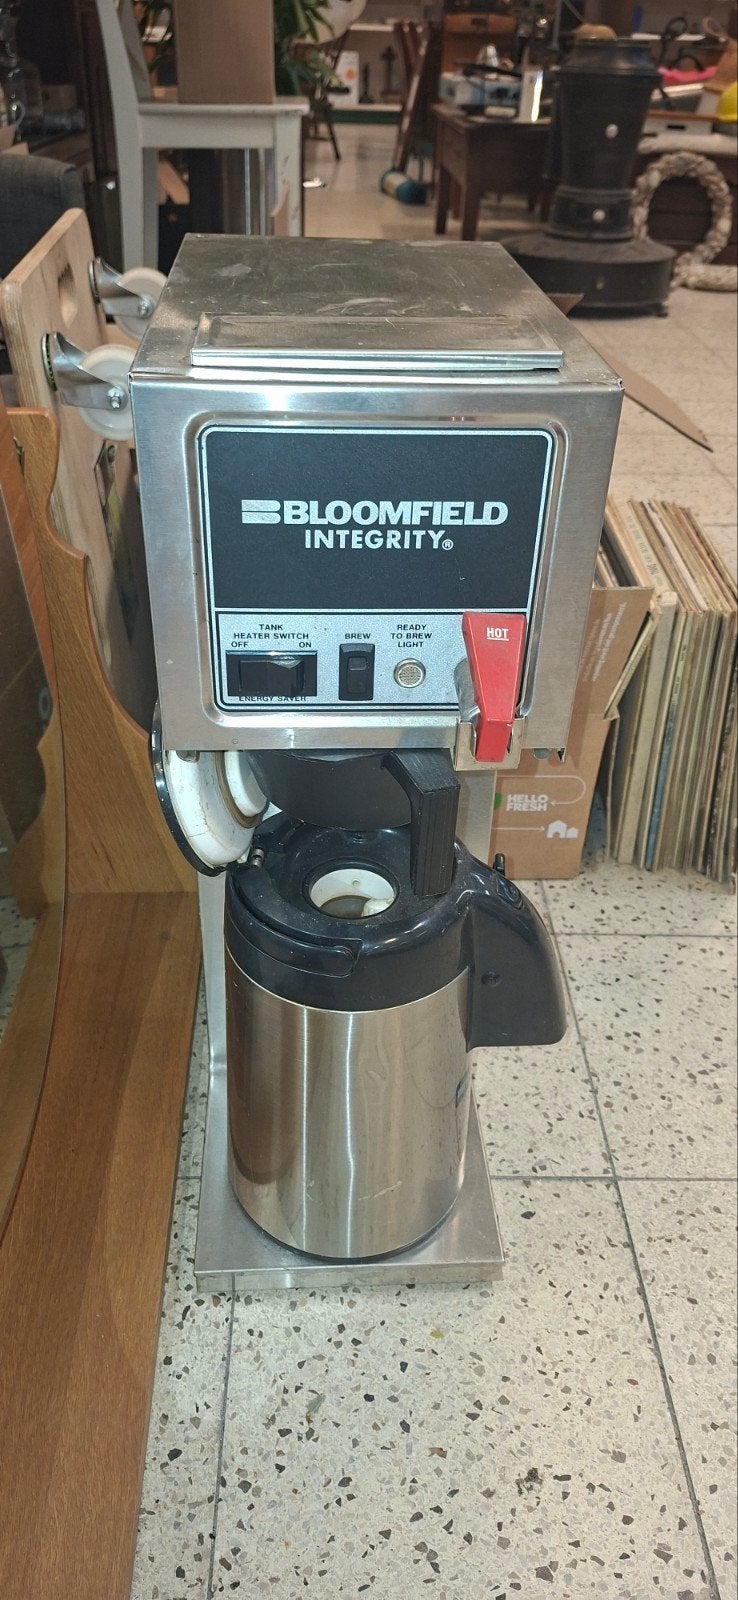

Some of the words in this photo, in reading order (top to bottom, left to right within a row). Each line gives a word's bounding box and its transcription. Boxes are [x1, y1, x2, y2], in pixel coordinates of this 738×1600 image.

[283, 500, 509, 526] BLOOMFIELD
[259, 623, 283, 631] TANK
[397, 623, 427, 631] READY
[233, 632, 270, 640] HEATER
[273, 632, 309, 640] SWITCH
[344, 632, 372, 640] BREW
[390, 632, 403, 640] TO
[406, 632, 433, 640] BREW
[486, 626, 509, 639] HOT
[506, 793, 549, 803] HELLO
[505, 802, 548, 812] FRESH
